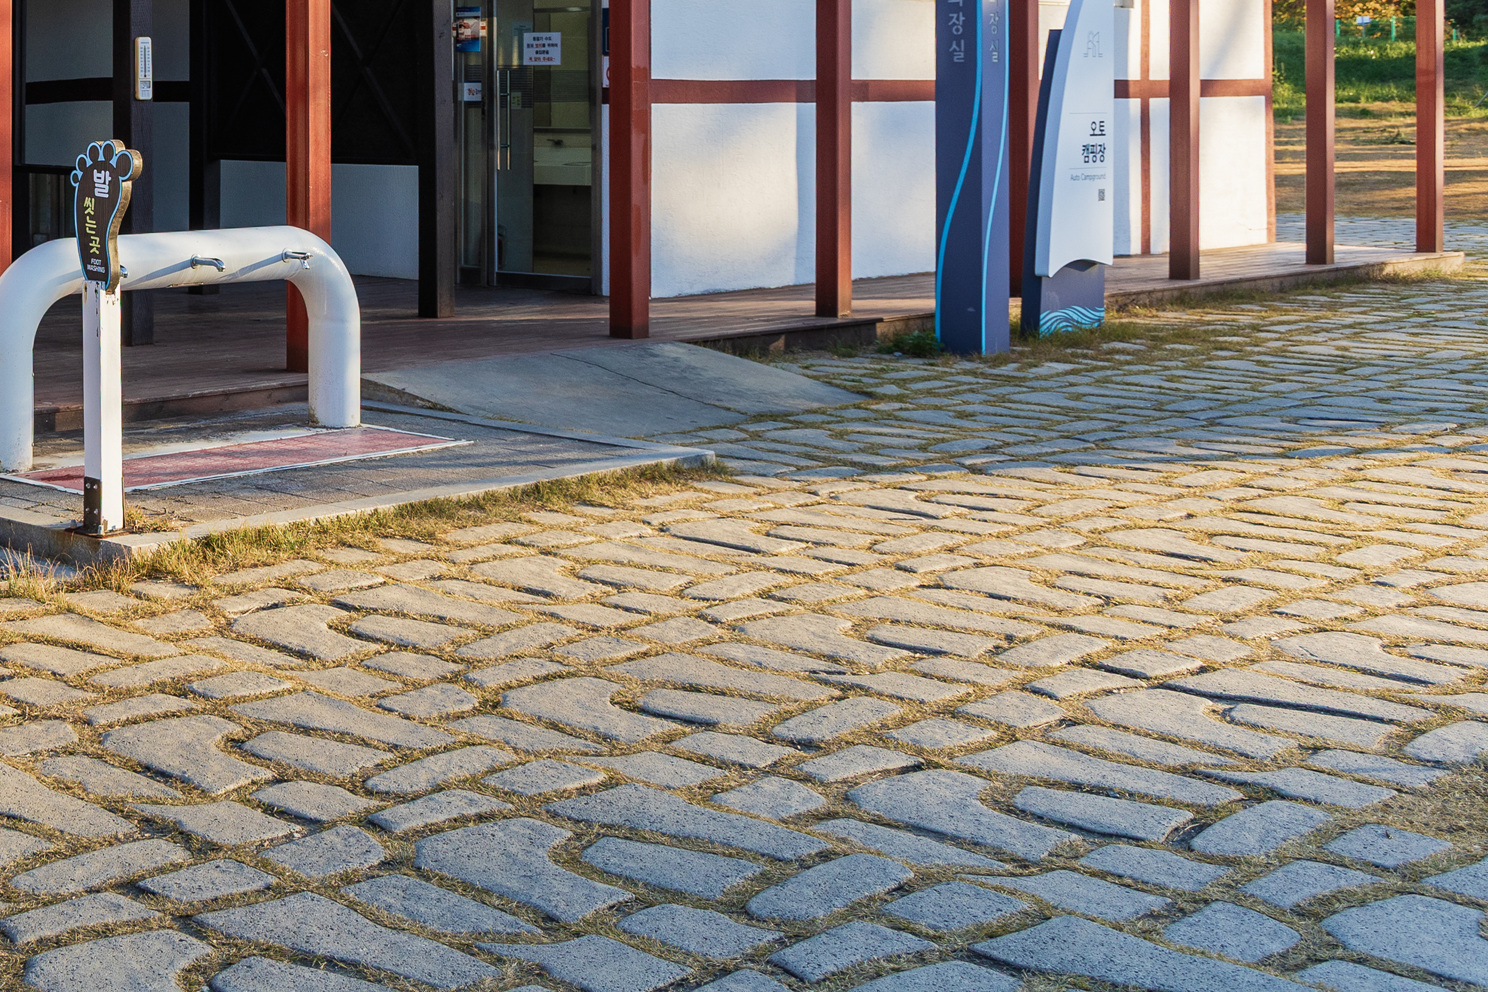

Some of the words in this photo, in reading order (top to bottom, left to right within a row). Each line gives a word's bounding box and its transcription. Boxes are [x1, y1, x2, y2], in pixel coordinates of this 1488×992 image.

[1089, 120, 1106, 136] 오토
[1081, 143, 1106, 163] 캠핑장
[93, 168, 112, 198] 발
[1070, 173, 1080, 181] Auto
[1081, 172, 1106, 182] Campground
[83, 196, 100, 255] 씻는곳
[86, 263, 105, 274] WASHING
